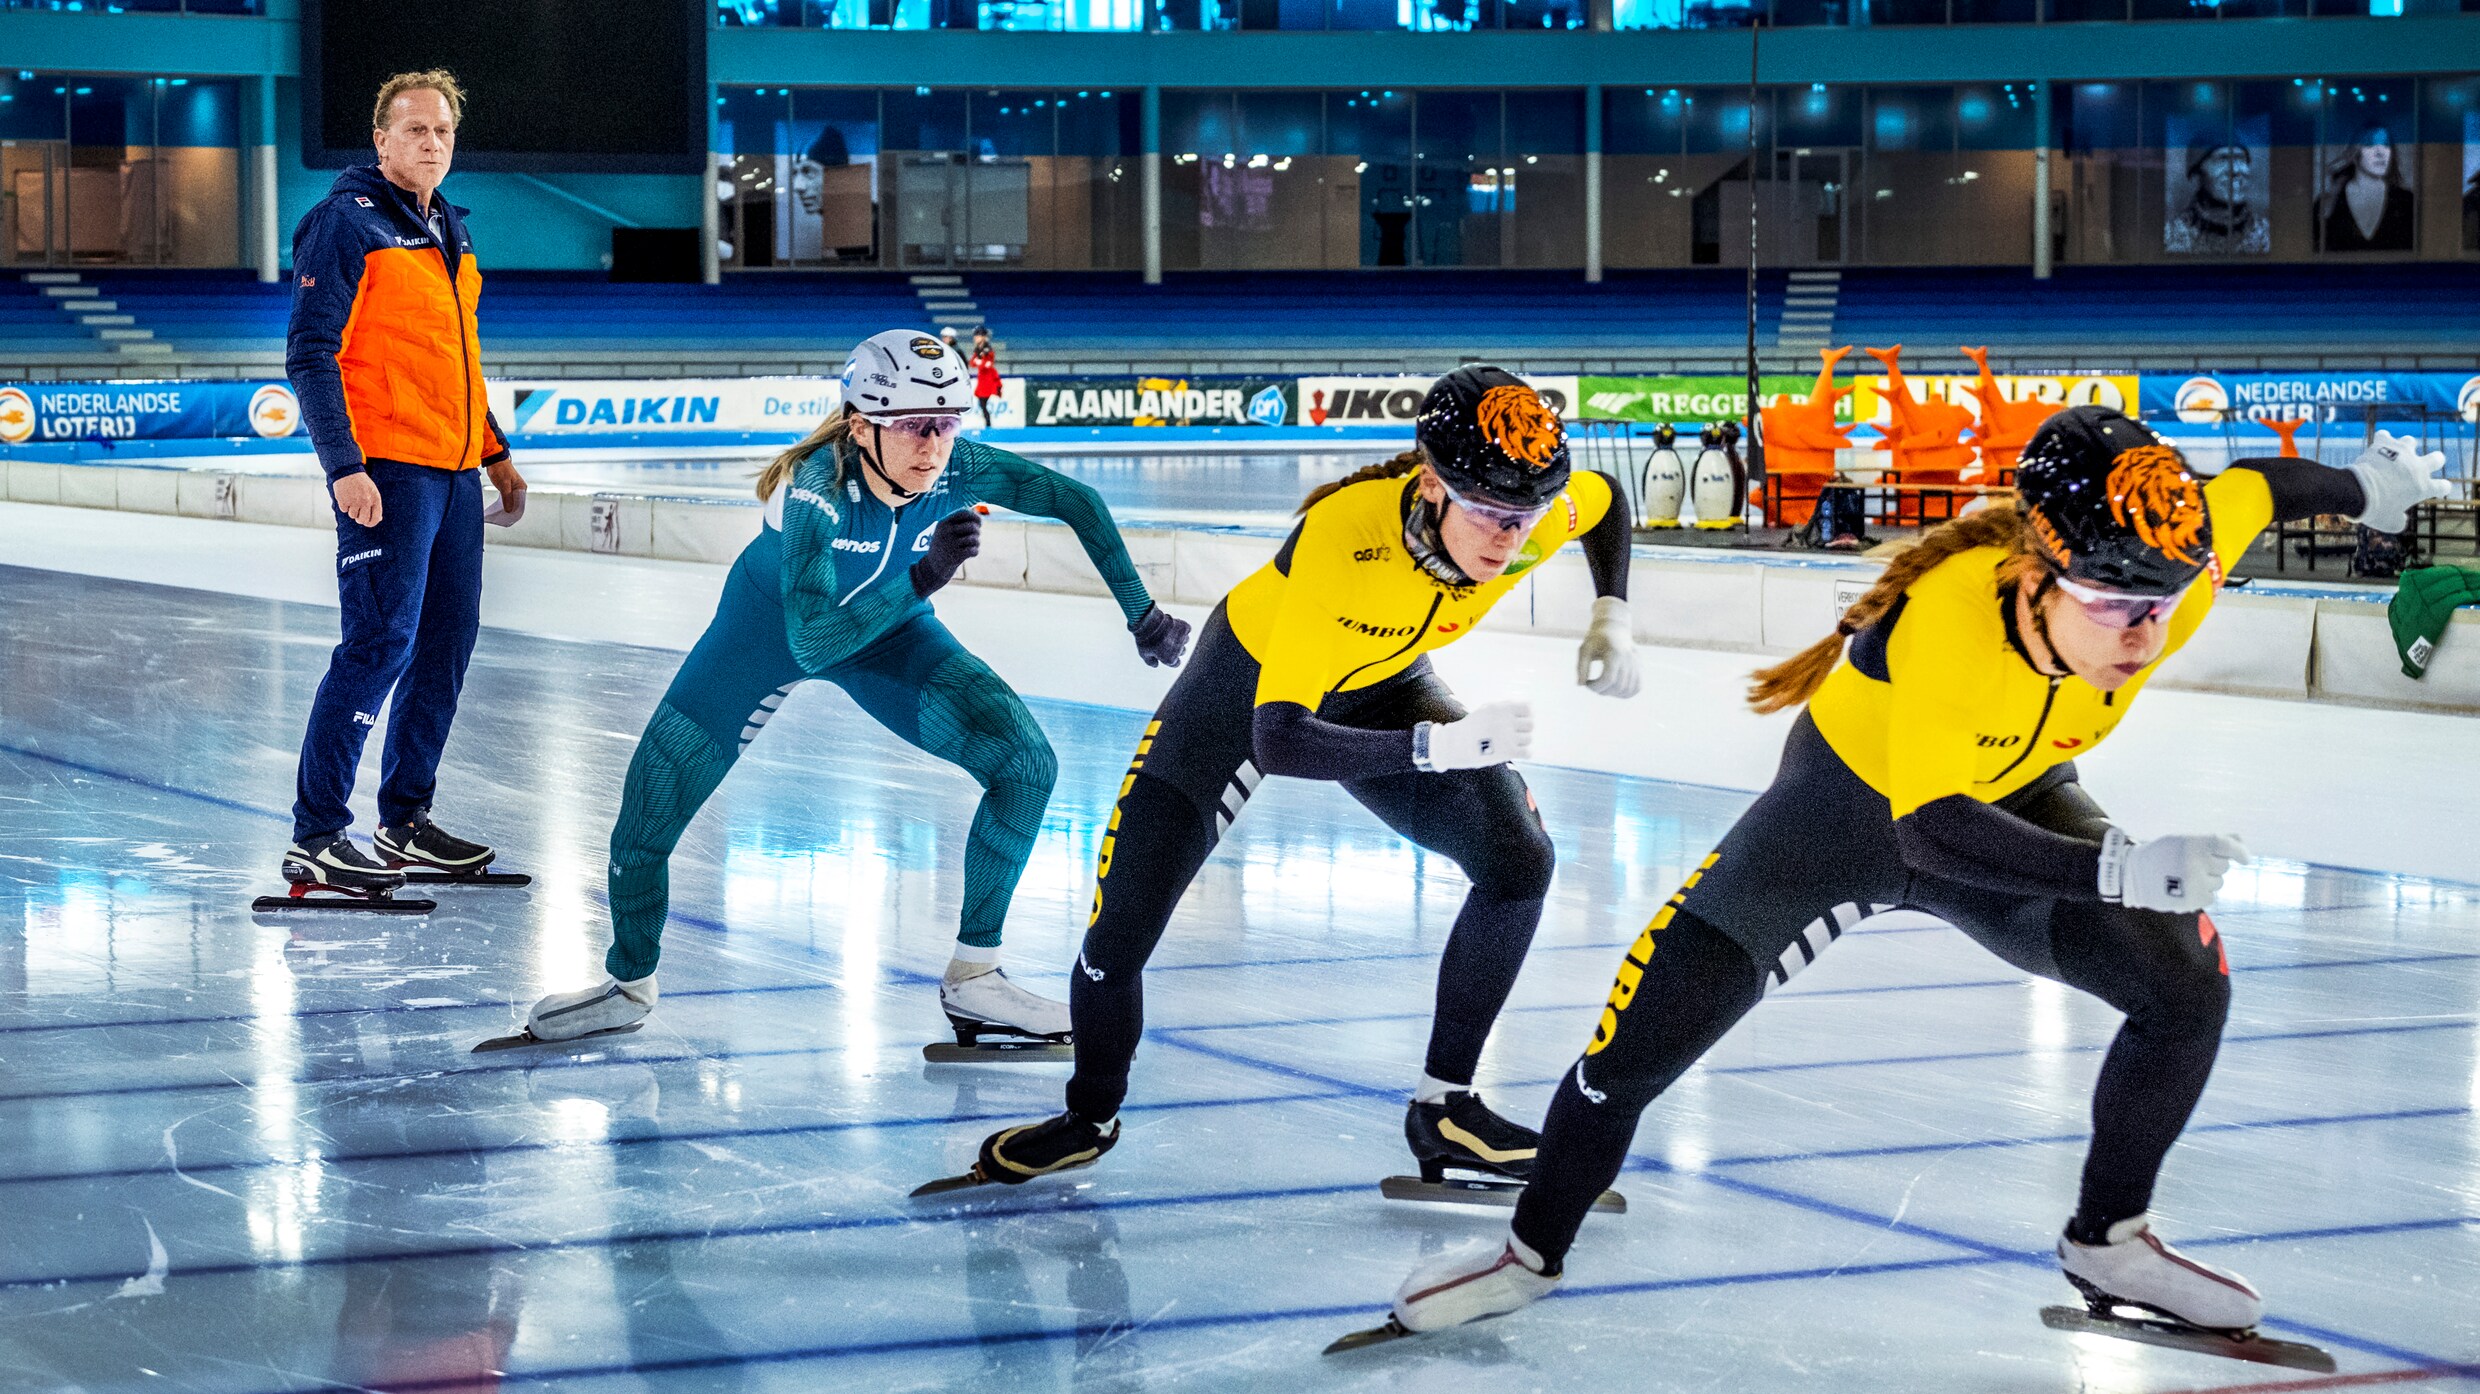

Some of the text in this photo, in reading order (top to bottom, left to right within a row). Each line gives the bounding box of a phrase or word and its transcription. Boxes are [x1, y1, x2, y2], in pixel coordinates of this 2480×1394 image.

[2235, 380, 2388, 402] NEDERLANDSE
[41, 392, 181, 415] NEDERLANDSE
[556, 396, 719, 425] DAIKIN
[764, 396, 792, 415] De
[1036, 388, 1247, 424] ZAANLANDER
[2235, 403, 2337, 424] LOTERJ
[43, 416, 136, 438] LOTERIJ
[789, 487, 840, 525] xenos
[348, 548, 382, 564] DAIKIN
[353, 711, 375, 726] FILA
